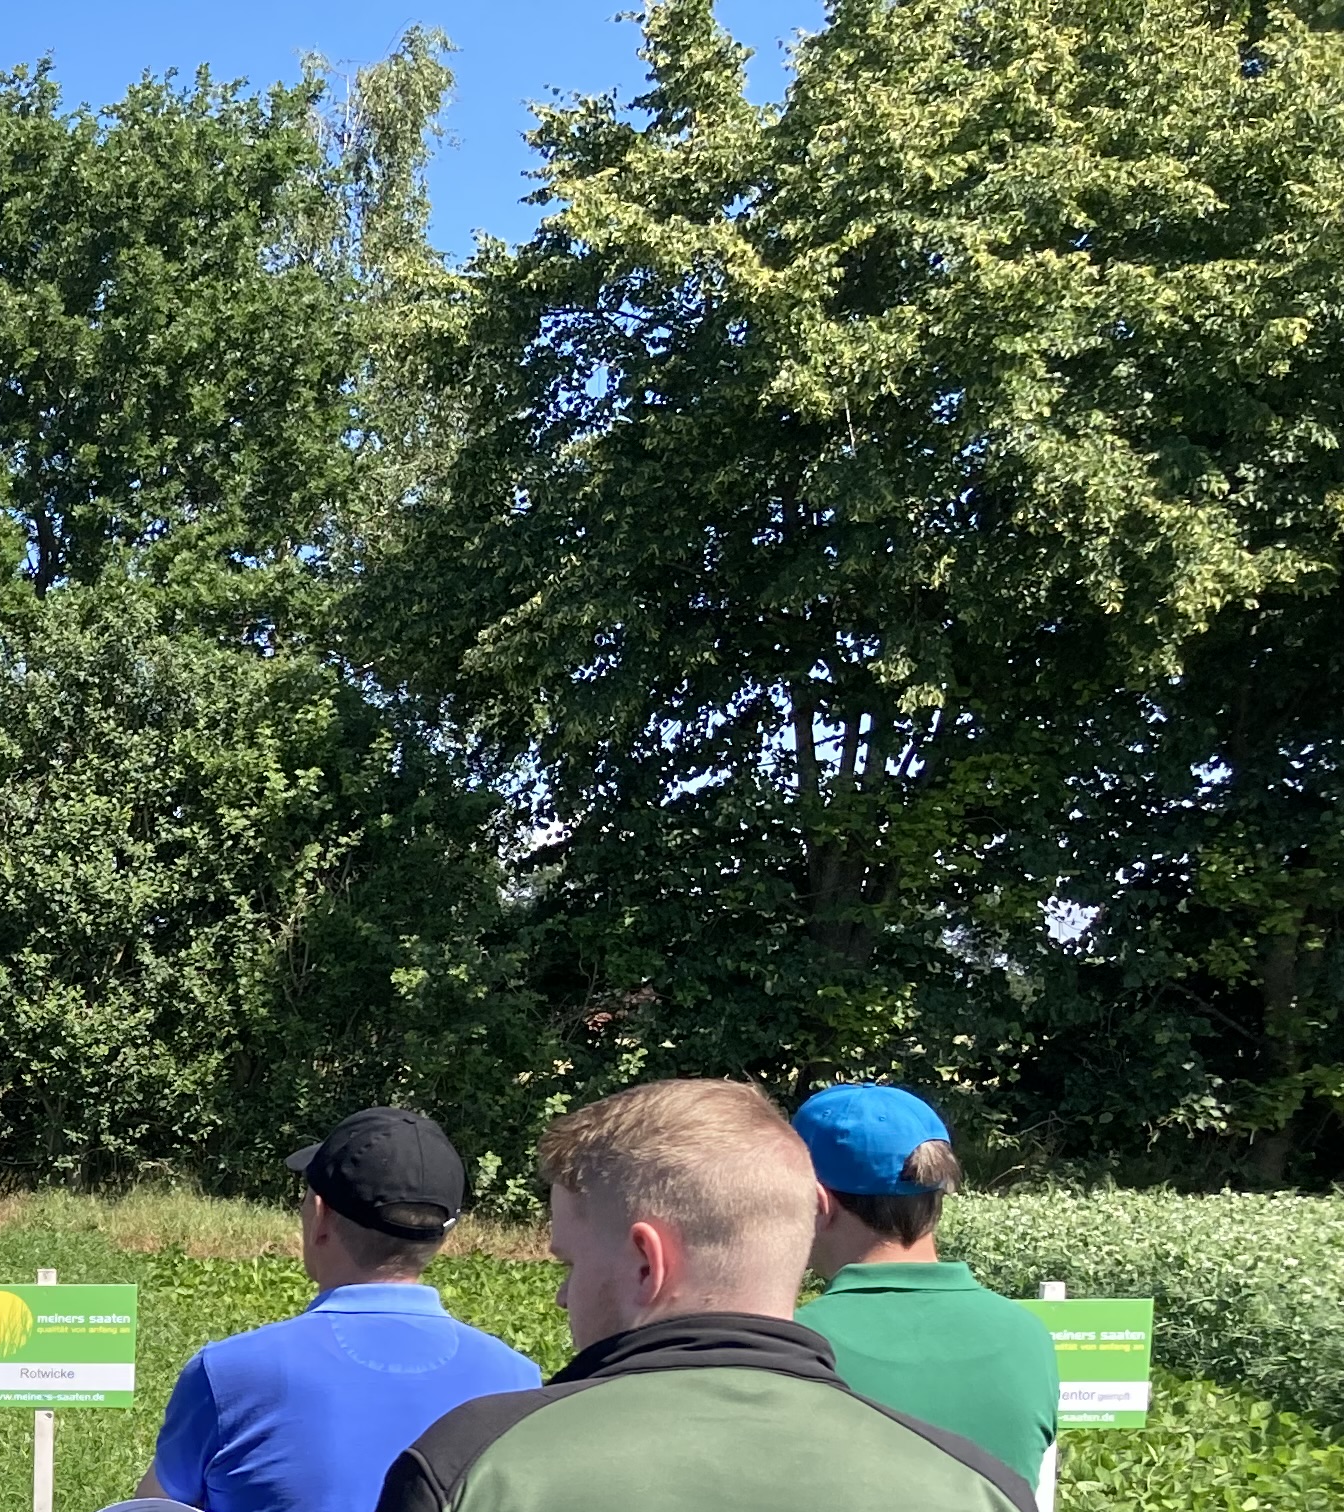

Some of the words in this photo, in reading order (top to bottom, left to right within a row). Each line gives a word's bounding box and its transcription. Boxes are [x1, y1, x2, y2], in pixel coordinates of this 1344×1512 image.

[37, 1312, 85, 1324] meiners
[89, 1312, 131, 1324] saaten
[1100, 1330, 1145, 1340] saaten
[20, 1367, 75, 1379] Rotwicke
[1058, 1390, 1096, 1400] entor
